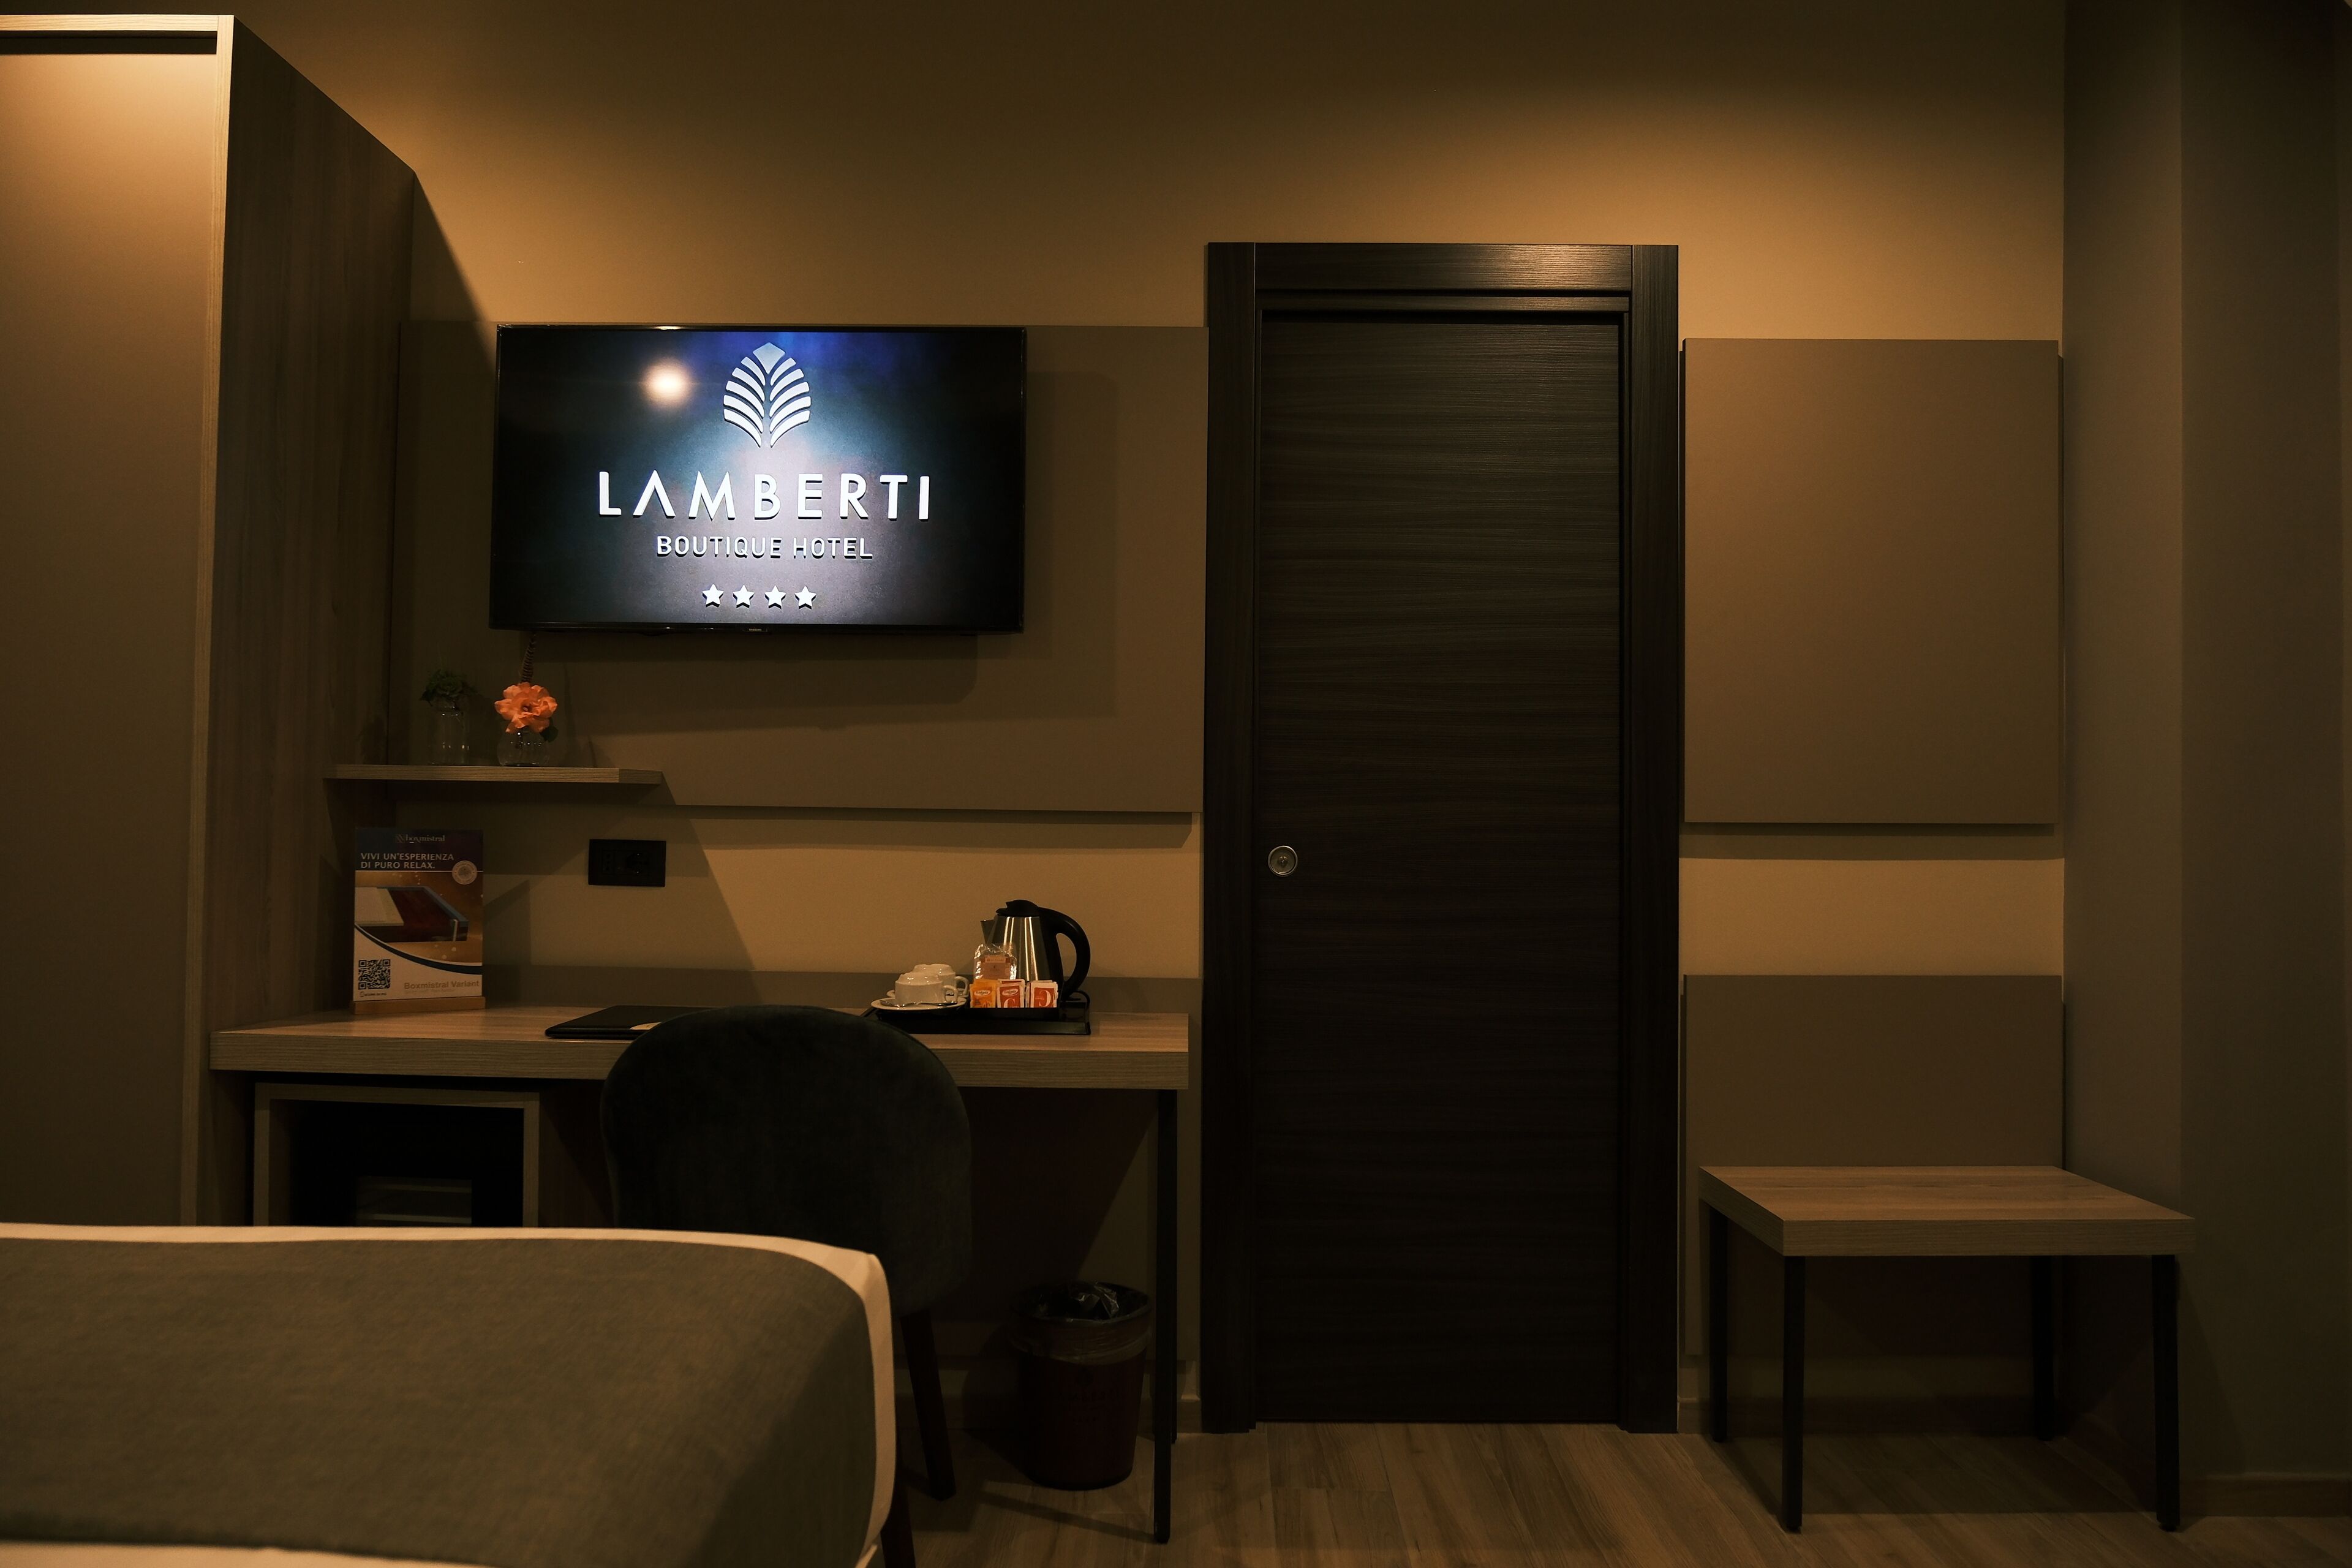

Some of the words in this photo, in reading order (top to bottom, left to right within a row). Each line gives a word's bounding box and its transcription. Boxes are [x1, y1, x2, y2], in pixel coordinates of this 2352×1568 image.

[599, 470, 930, 521] LAMBERTI
[657, 536, 782, 558] BOUTIQUE
[793, 537, 873, 559] HOTEL
